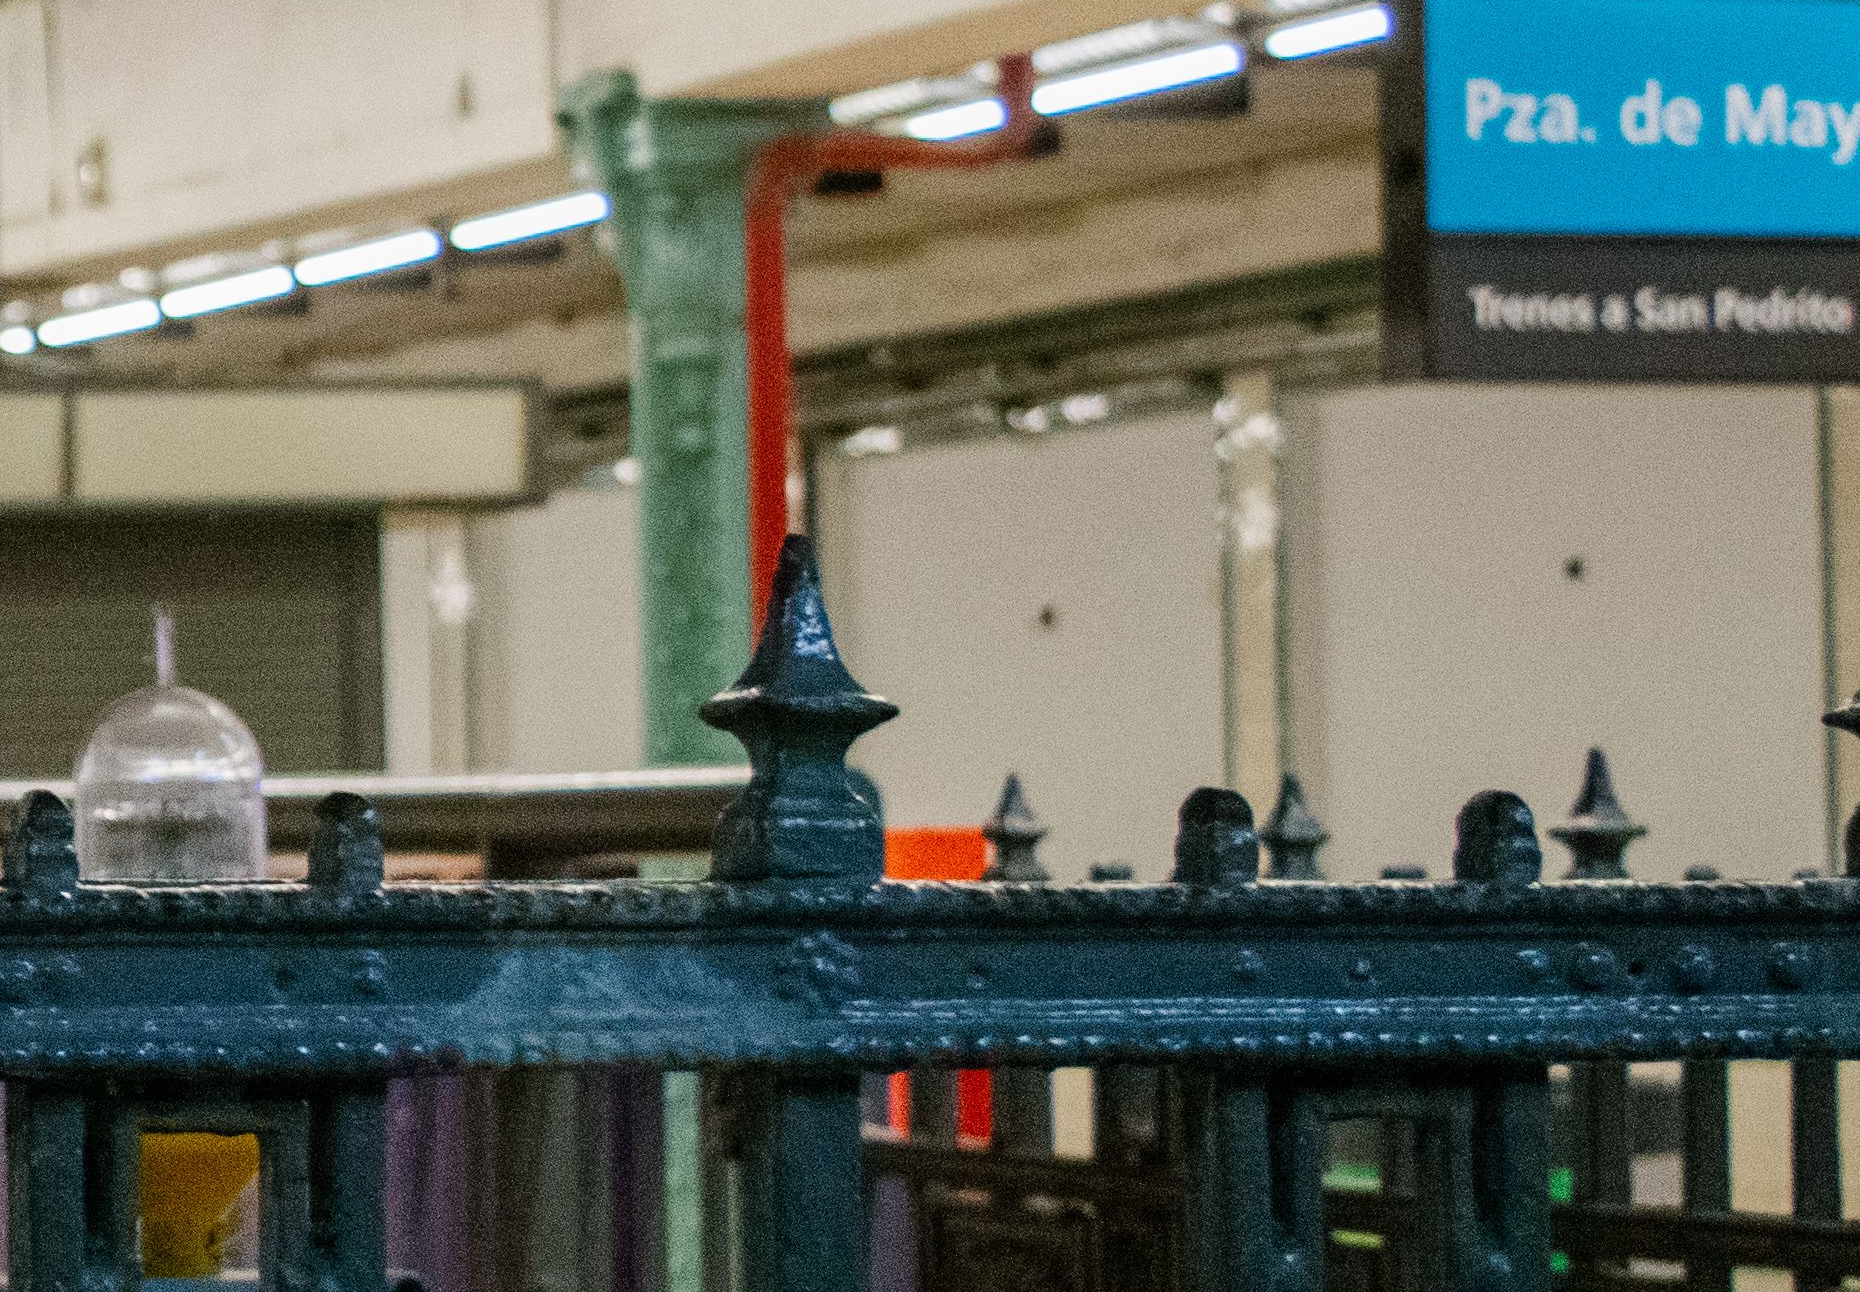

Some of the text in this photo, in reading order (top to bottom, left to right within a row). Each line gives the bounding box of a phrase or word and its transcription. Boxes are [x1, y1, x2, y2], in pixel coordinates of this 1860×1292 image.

[1465, 77, 1860, 165] Pza. de May
[1469, 286, 1853, 333] Trenes a San Pedrito
